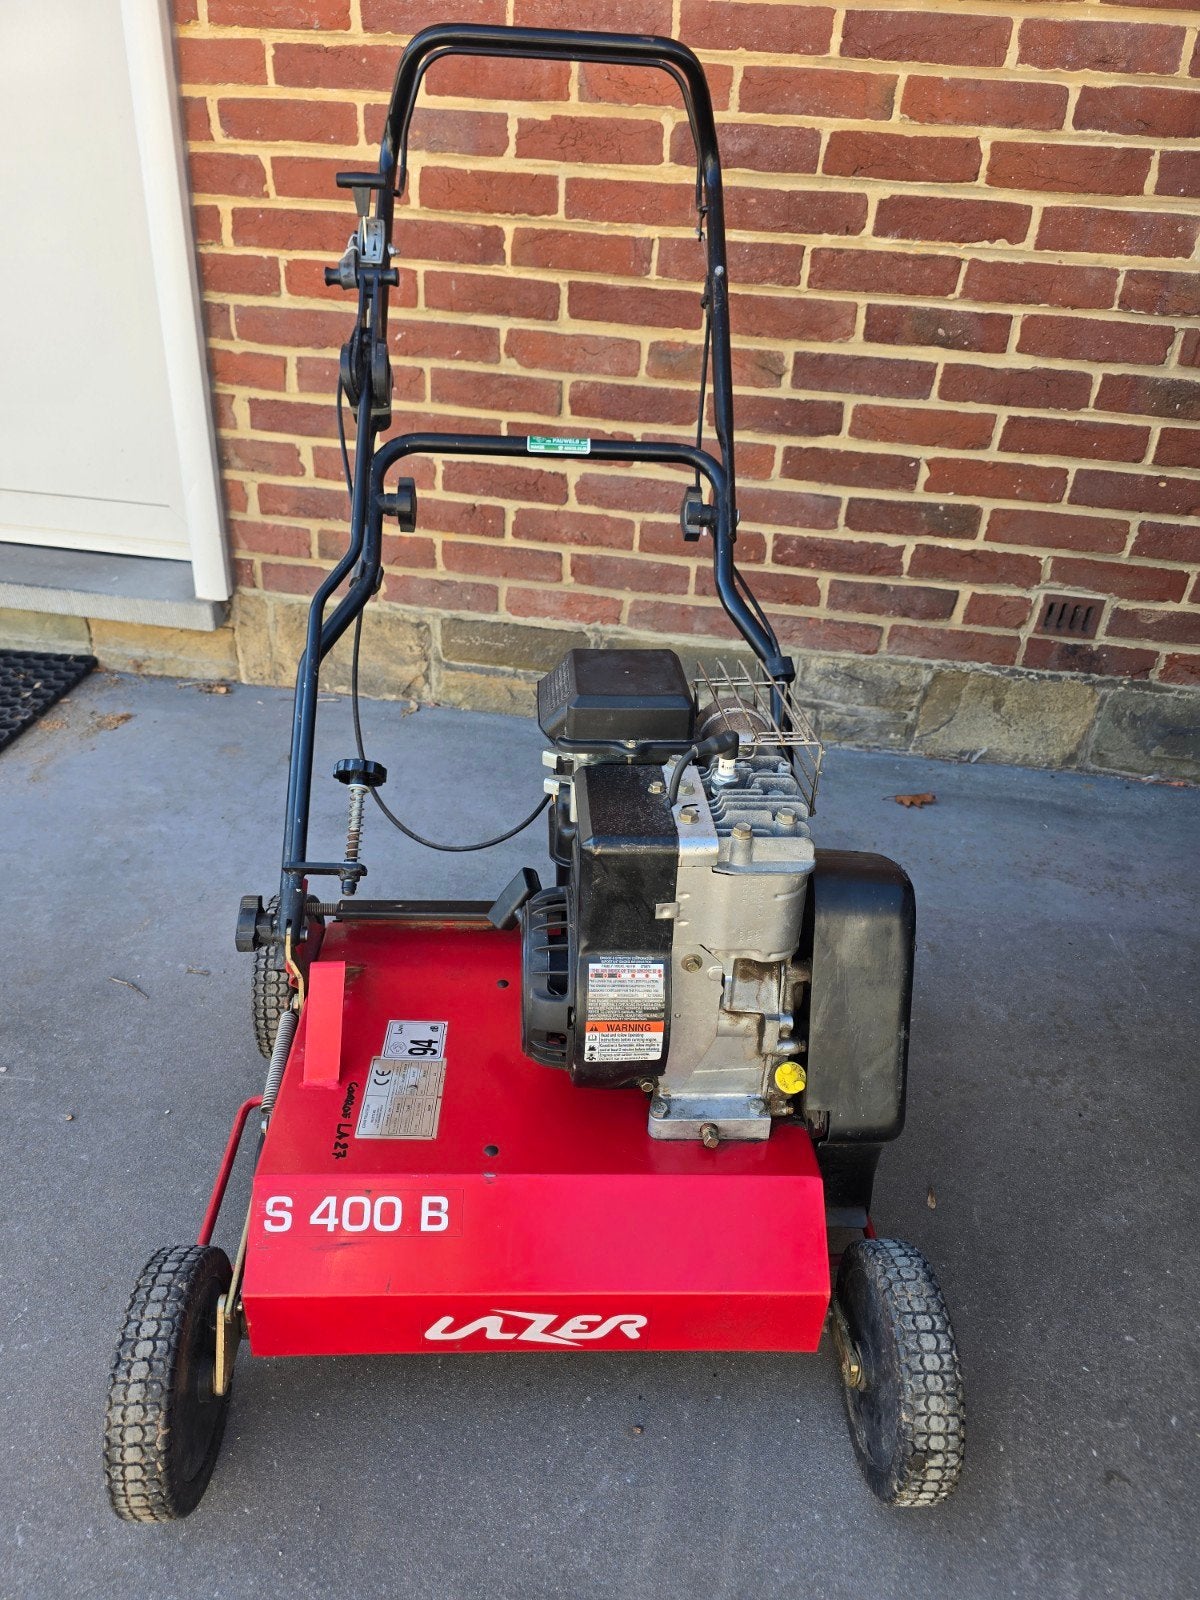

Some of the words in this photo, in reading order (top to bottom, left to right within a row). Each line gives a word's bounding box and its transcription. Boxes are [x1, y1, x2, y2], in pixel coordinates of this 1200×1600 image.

[407, 1038, 439, 1056] 94
[429, 1025, 439, 1033] dB
[606, 1023, 651, 1032] WARNING
[373, 1069, 392, 1086] CE
[263, 1195, 293, 1233] S
[309, 1195, 403, 1233] 400
[420, 1195, 449, 1233] B
[423, 1308, 648, 1348] LAZER
